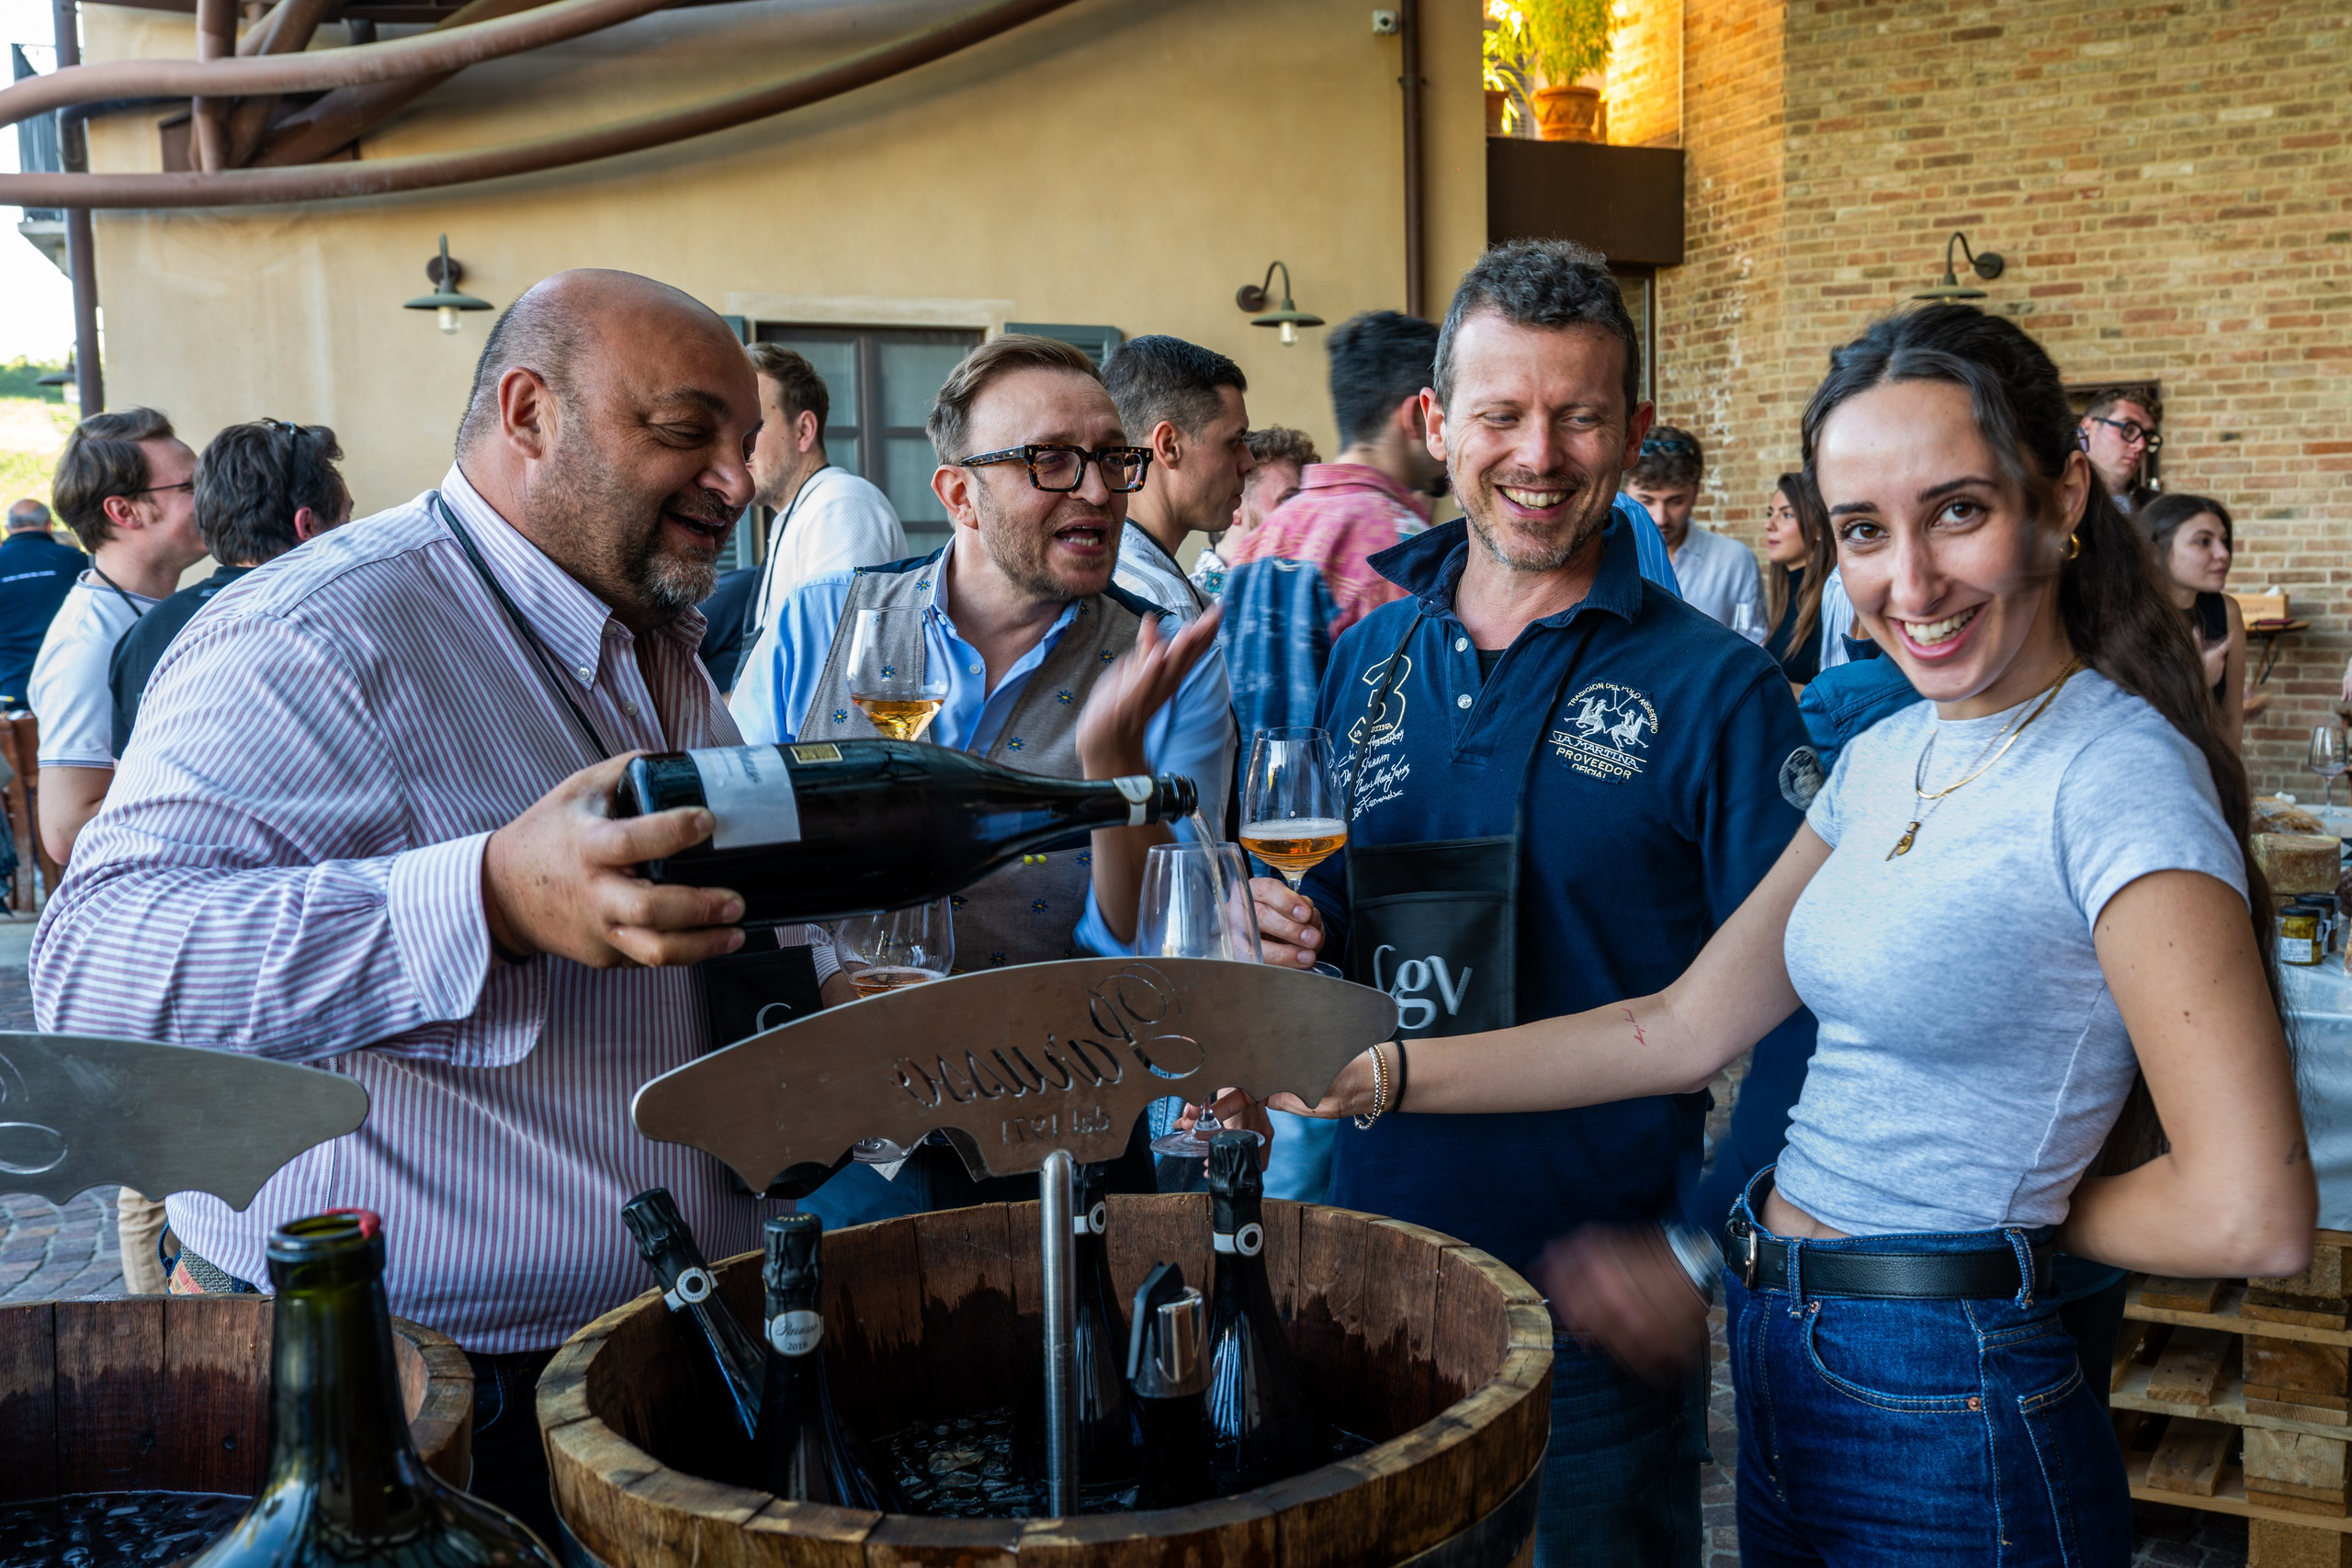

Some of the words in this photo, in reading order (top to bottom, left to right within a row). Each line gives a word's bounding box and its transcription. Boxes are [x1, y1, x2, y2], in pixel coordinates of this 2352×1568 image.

[1348, 653, 1411, 744] 3
[1605, 682, 1620, 692] DEL
[1553, 733, 1573, 746] LA
[1574, 739, 1639, 769] MARTINA
[1555, 747, 1632, 780] PROVEEDOR
